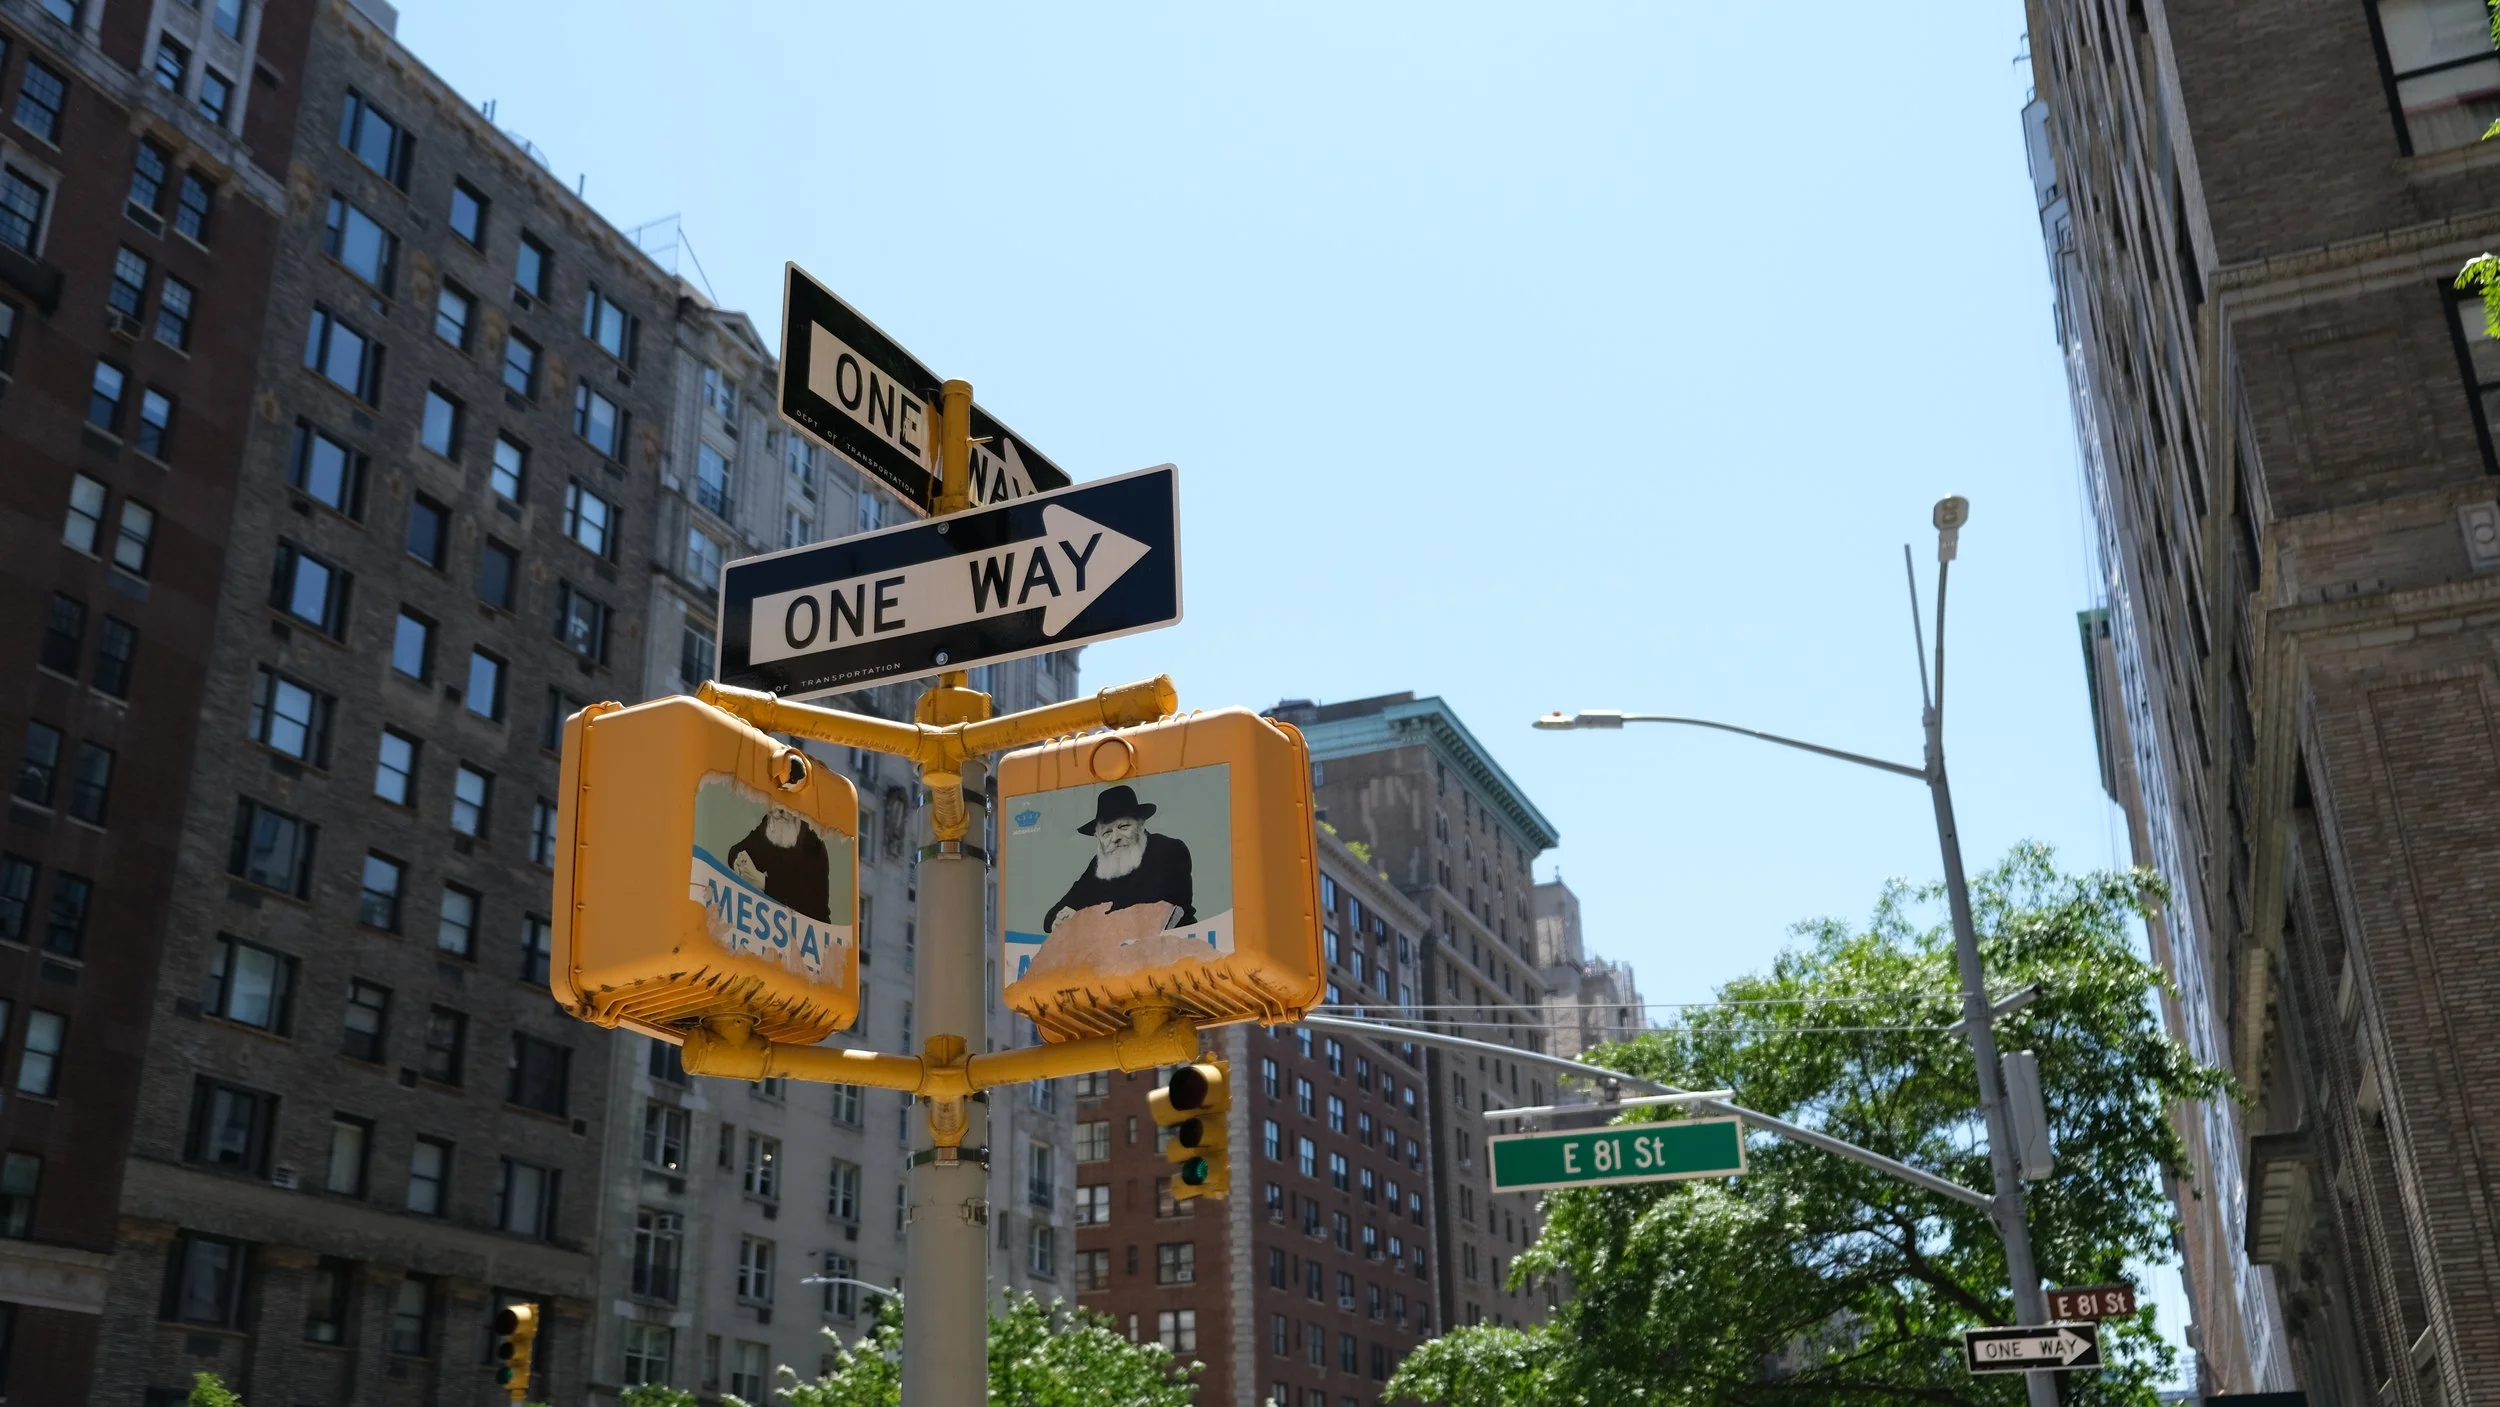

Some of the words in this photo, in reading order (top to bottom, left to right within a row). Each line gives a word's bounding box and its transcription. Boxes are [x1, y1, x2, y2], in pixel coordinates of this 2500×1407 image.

[836, 353, 922, 458] ONE
[796, 410, 818, 427] DEPT
[827, 430, 838, 441] OF
[846, 443, 915, 495] TRANSPORTATION
[785, 575, 906, 650] ONE
[969, 532, 1103, 614] WAY
[775, 683, 789, 692] OF
[801, 662, 901, 688] TRANSPORTATION
[1564, 1142, 1581, 1174] E
[1594, 1139, 1621, 1172] 81
[1634, 1136, 1666, 1168] St
[2057, 1296, 2072, 1318] E
[2077, 1294, 2099, 1316] 81
[2105, 1292, 2128, 1314] St
[1985, 1341, 2023, 1359] ONE
[2039, 1338, 2078, 1358] WAY
